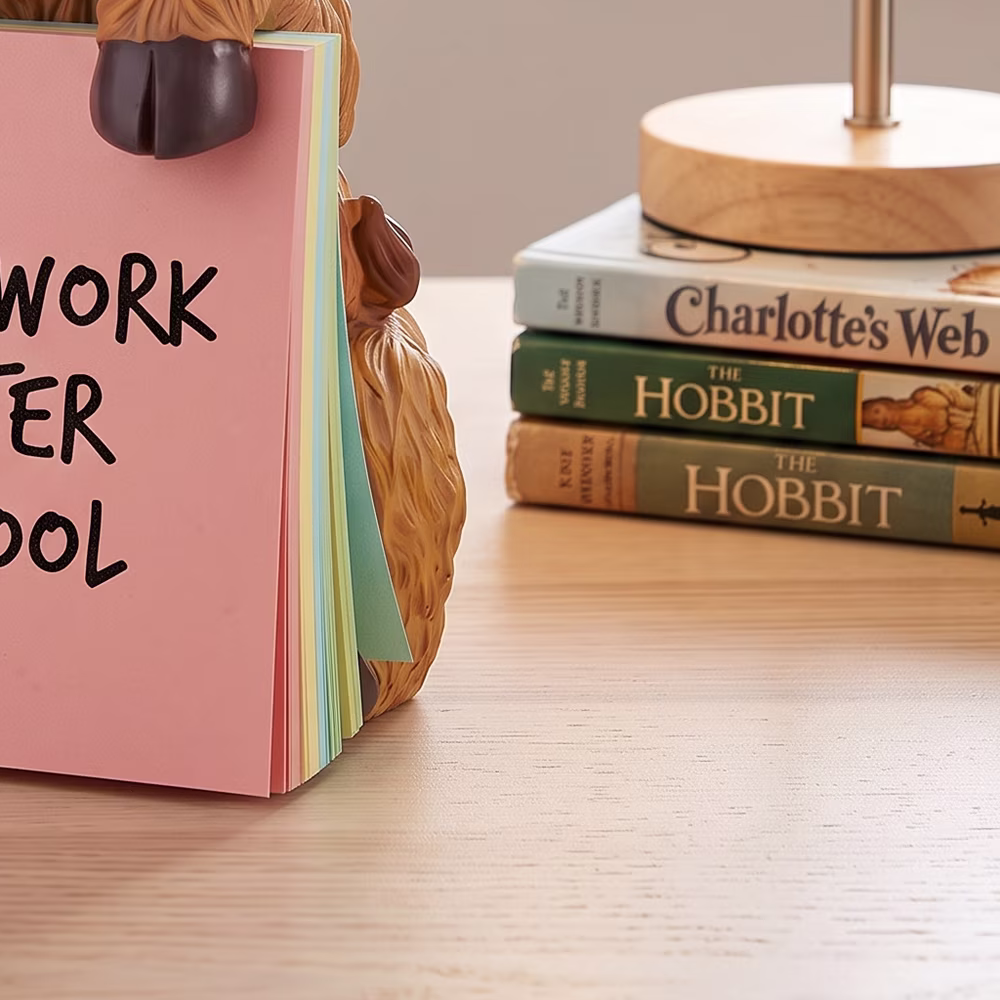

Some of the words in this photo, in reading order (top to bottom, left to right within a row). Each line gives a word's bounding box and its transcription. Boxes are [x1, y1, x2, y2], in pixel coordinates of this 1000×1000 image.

[665, 284, 889, 350] Charlotte's
[895, 306, 989, 358] Web
[707, 365, 742, 382] THE
[634, 375, 815, 429] HOBBIT
[775, 453, 817, 473] THE
[685, 464, 902, 529] HOBBIT
